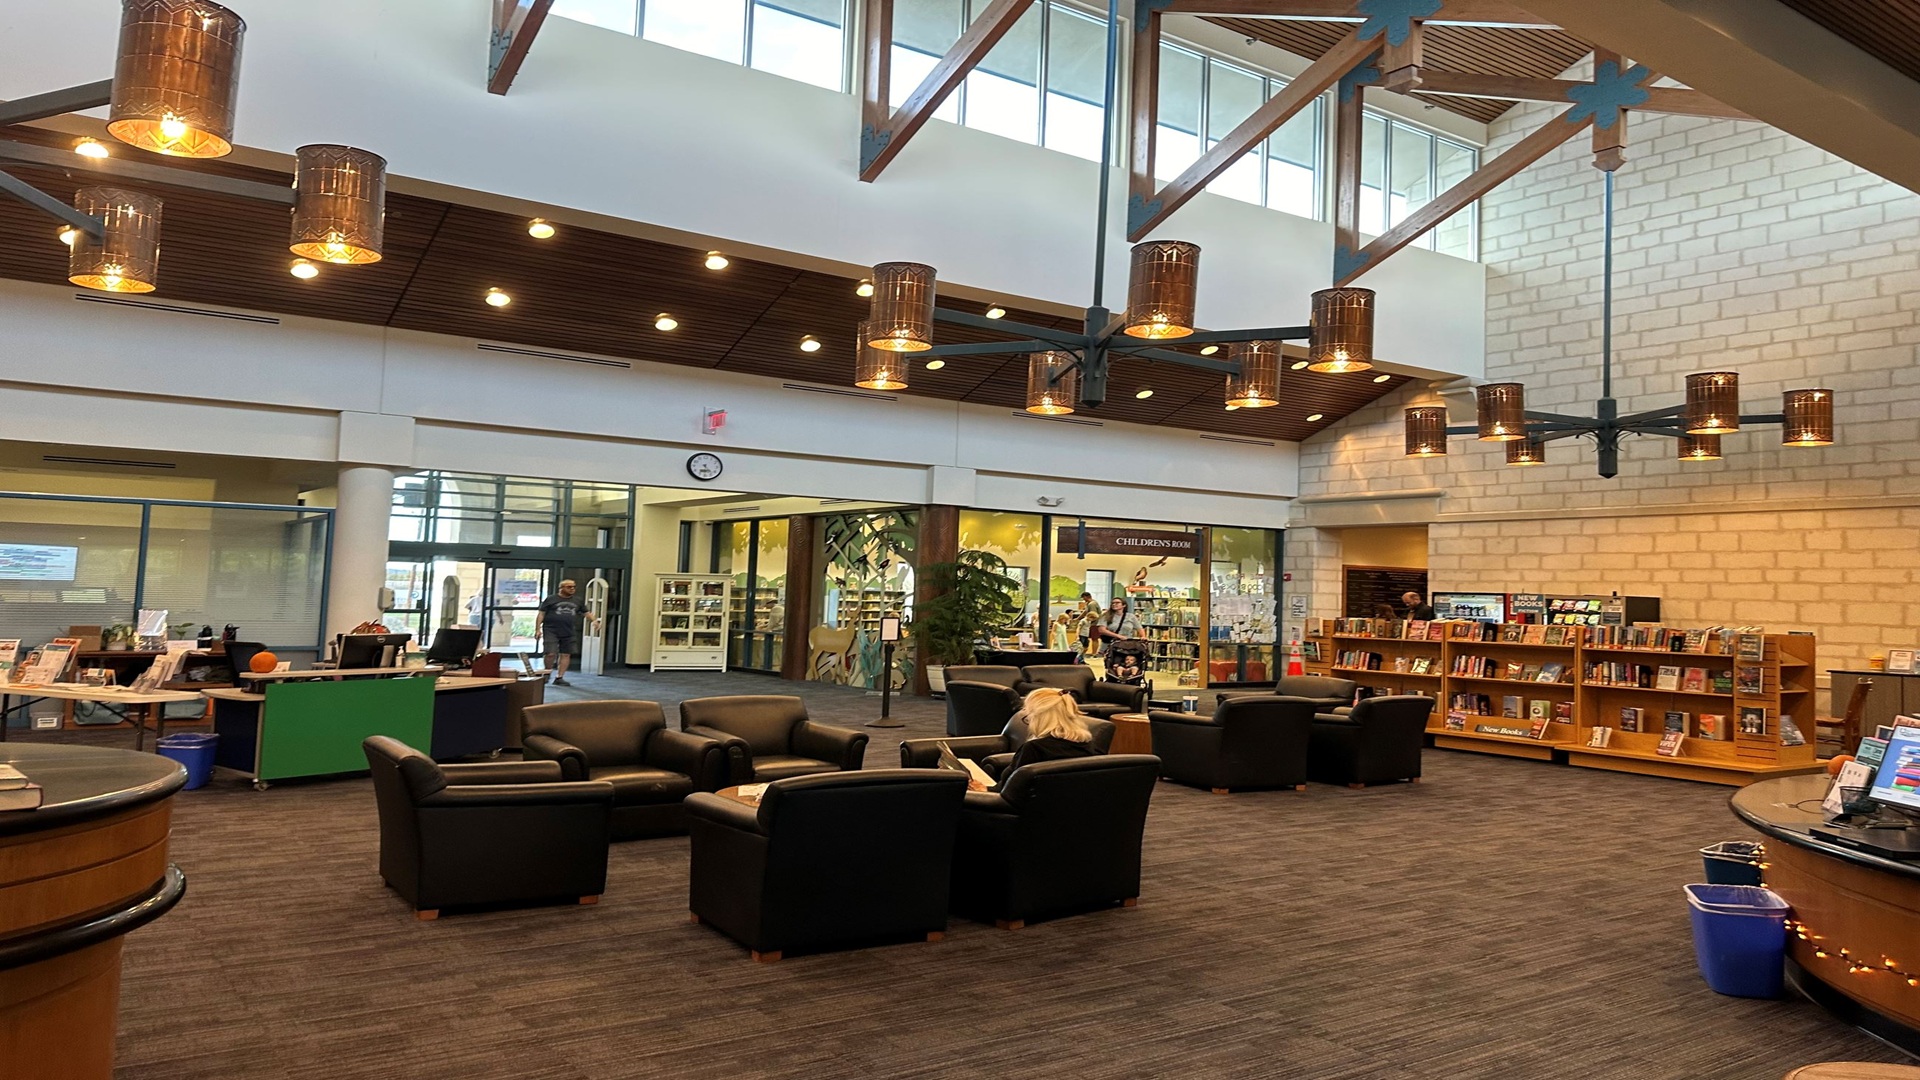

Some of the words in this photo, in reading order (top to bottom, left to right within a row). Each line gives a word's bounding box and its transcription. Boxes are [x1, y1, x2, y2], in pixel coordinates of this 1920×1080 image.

[1116, 537, 1171, 547] CHILDREN'S
[1482, 726, 1499, 734] New
[1500, 728, 1522, 736] Books
